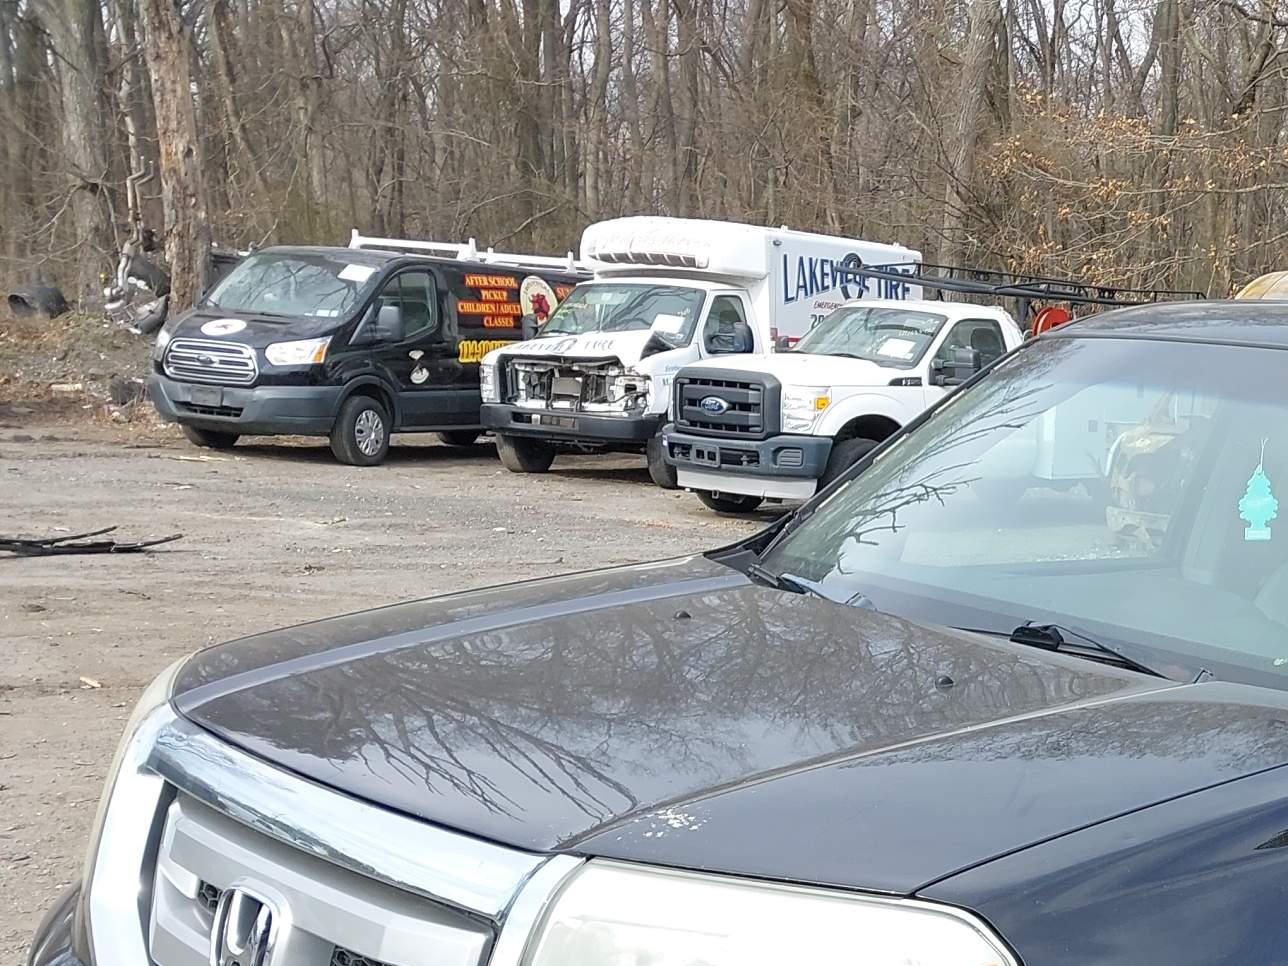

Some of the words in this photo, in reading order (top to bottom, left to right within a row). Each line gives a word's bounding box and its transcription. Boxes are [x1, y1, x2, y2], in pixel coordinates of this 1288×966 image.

[489, 276, 518, 288] SCHOOL
[459, 303, 495, 313] CHILDREN
[484, 316, 514, 328] CLASSES
